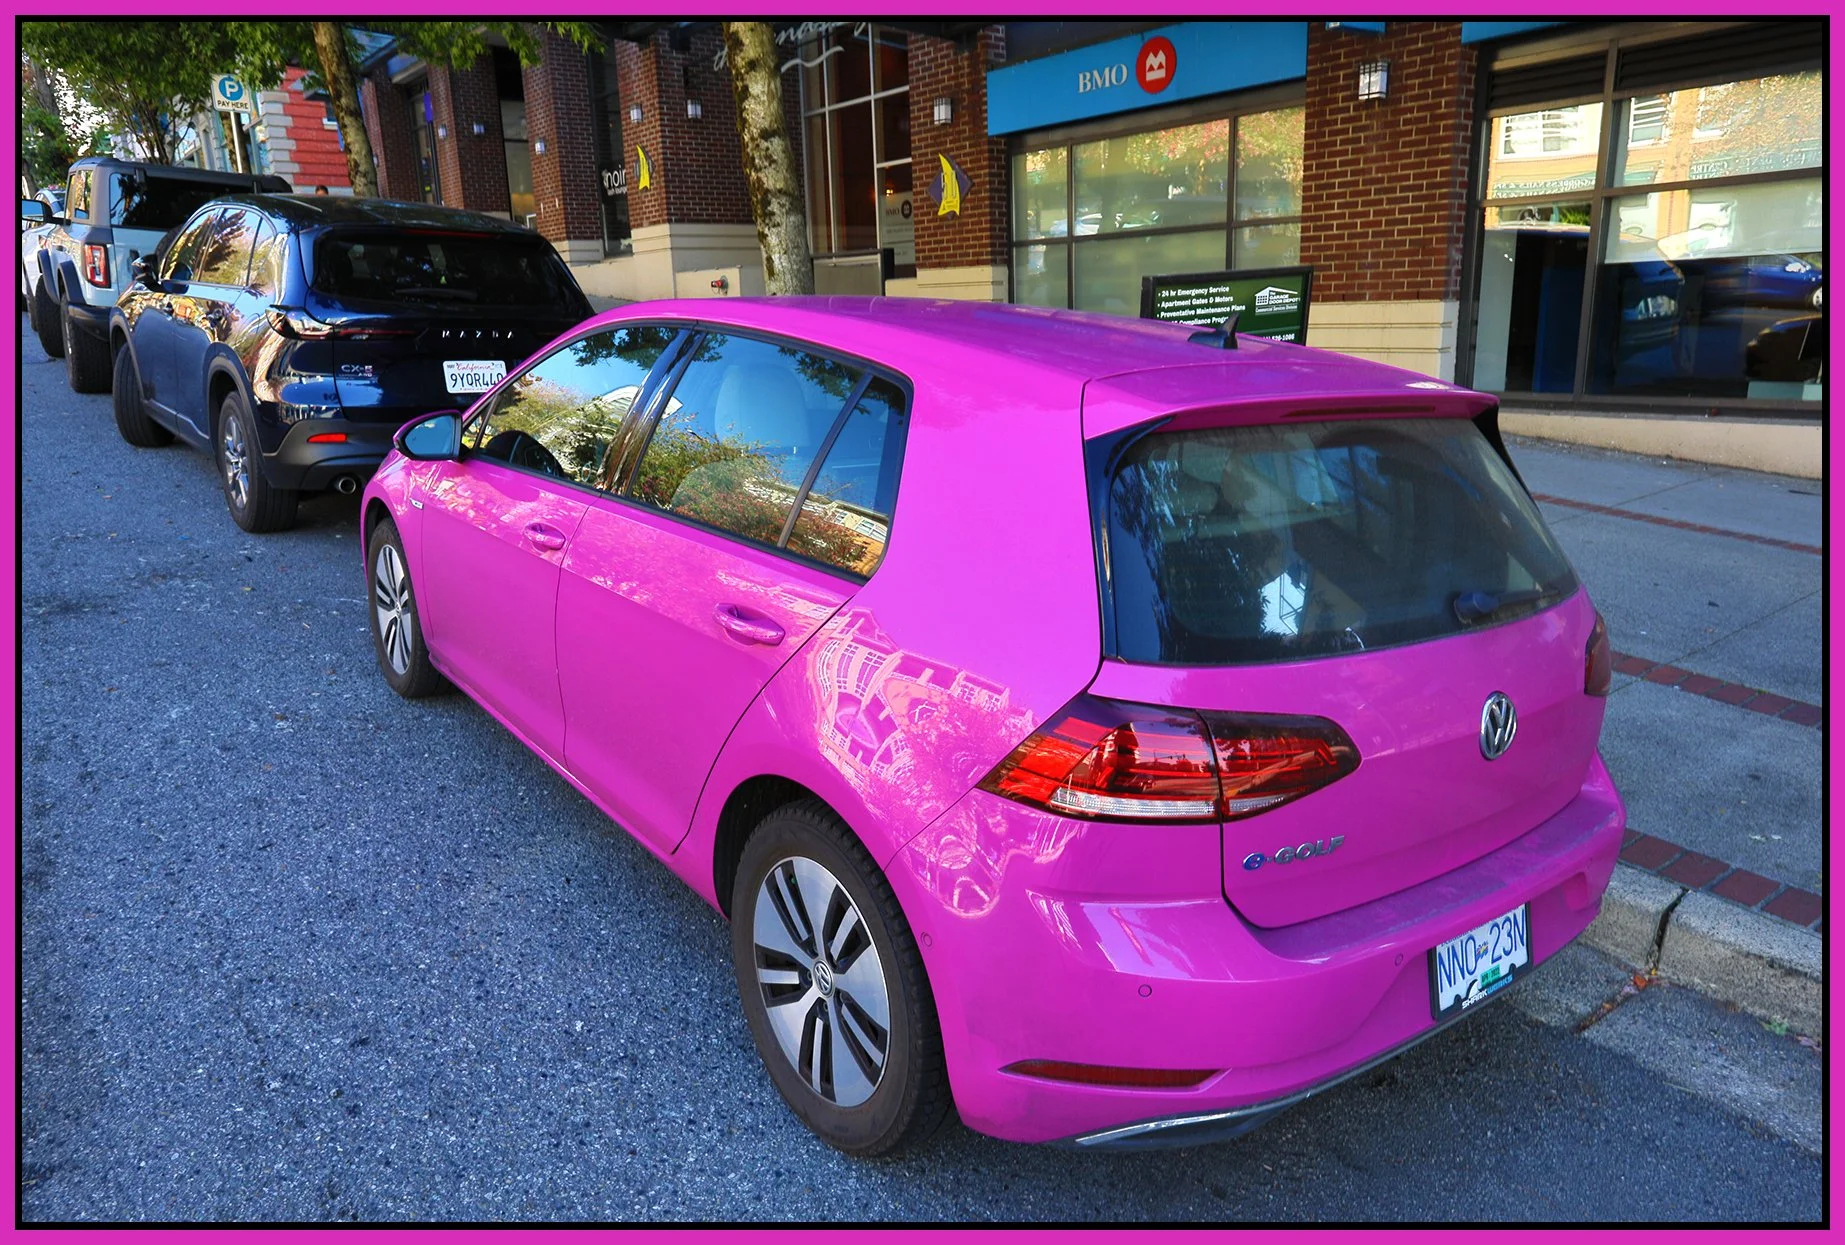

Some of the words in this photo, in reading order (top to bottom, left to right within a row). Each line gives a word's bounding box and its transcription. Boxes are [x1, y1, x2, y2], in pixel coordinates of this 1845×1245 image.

[1078, 63, 1128, 93] BMO
[605, 163, 626, 189] noir
[1177, 287, 1208, 296] Emergency
[1161, 299, 1191, 309] Apartment
[1160, 309, 1196, 318] Preventative
[1196, 306, 1231, 315] Maintenance
[1231, 304, 1246, 312] Plans
[1212, 316, 1229, 324] Progr
[341, 364, 373, 373] CX-5
[456, 362, 494, 372] California
[1489, 908, 1525, 965] 23N
